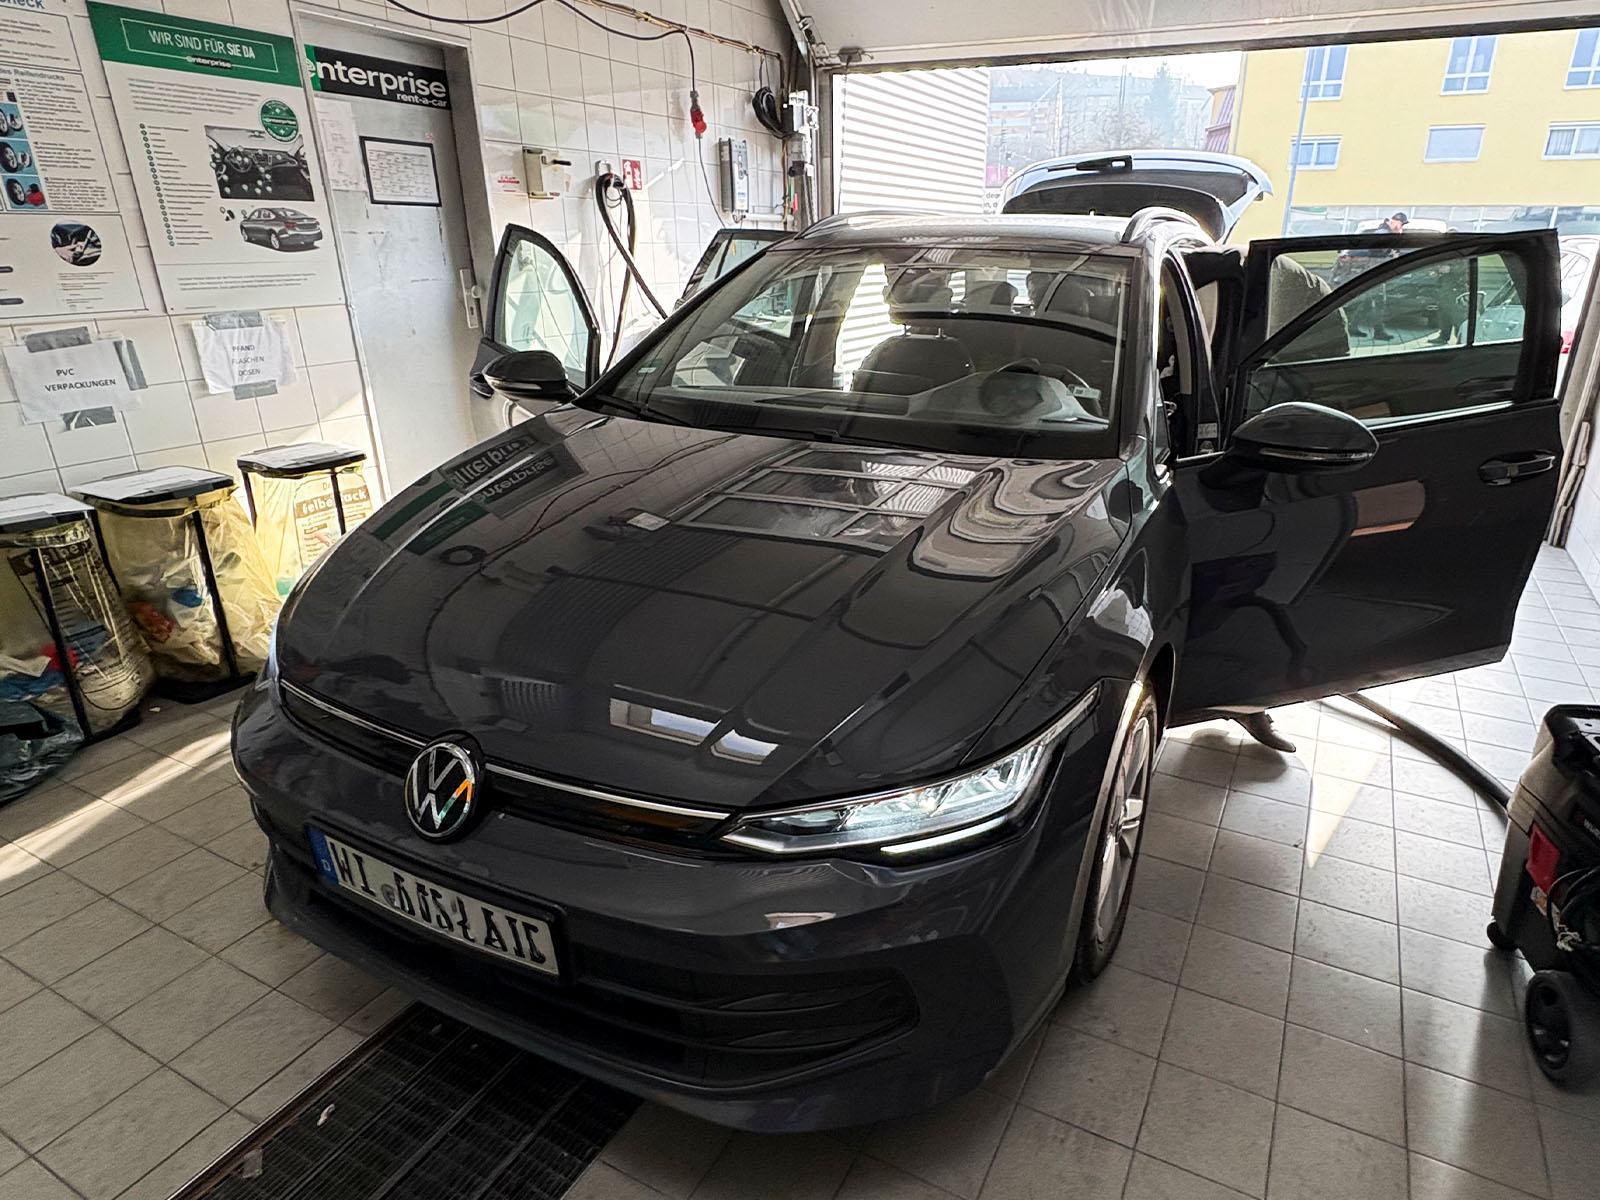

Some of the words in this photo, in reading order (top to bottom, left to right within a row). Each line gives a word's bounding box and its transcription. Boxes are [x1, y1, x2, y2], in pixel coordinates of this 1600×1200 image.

[148, 30, 173, 46] WIR
[174, 34, 201, 51] SIND
[203, 38, 226, 55] FÜR
[226, 42, 242, 57] SIE
[242, 45, 256, 59] DA
[396, 93, 447, 108] rent-a-car
[232, 344, 255, 352] PFAND
[232, 355, 265, 364] FLASCHEN
[56, 368, 75, 377] PVC
[238, 368, 261, 377] DOSEN
[44, 379, 116, 392] VERPACKUNGEN
[342, 488, 367, 503] ack
